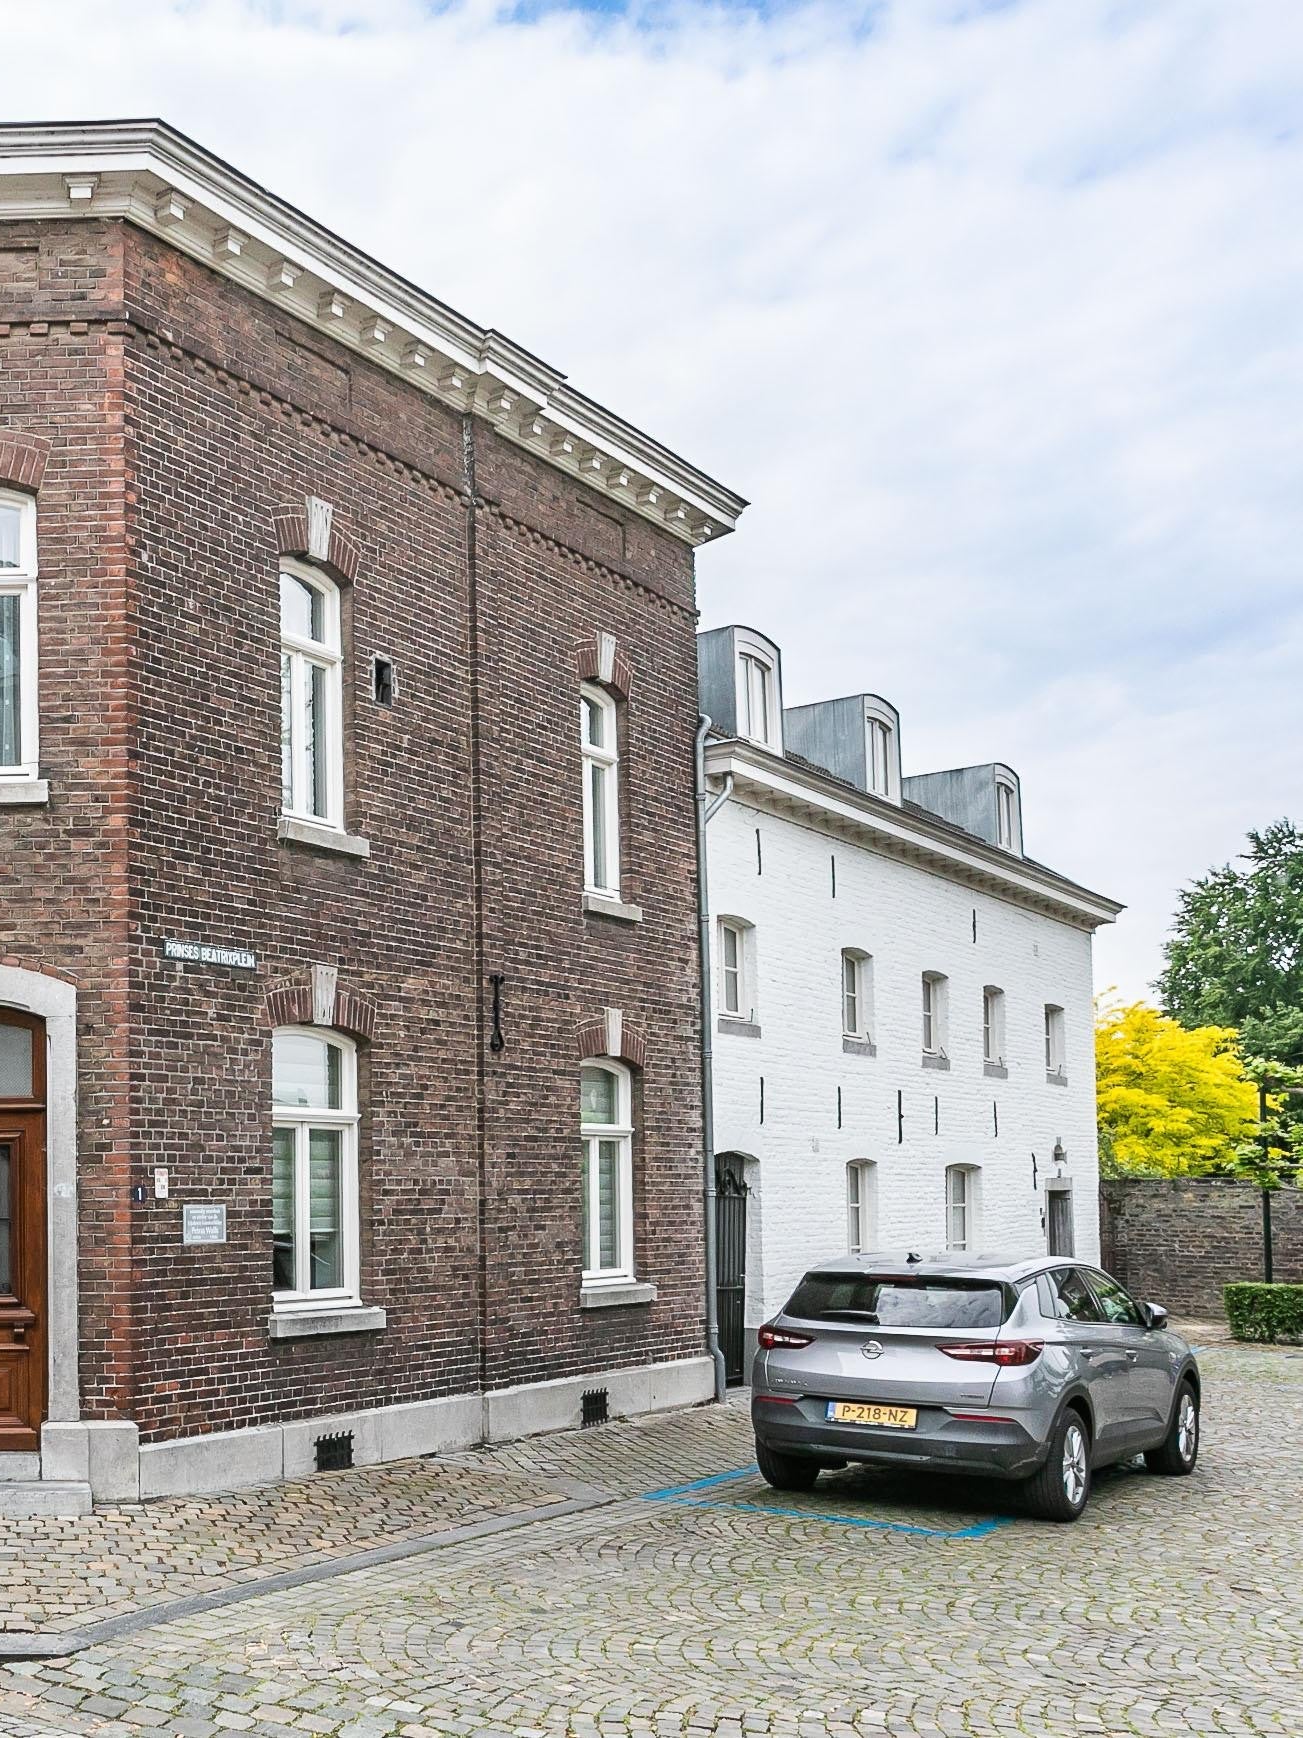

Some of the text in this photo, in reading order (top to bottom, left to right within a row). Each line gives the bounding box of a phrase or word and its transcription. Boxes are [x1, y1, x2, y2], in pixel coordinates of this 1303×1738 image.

[165, 942, 255, 967] PRINSES BEATRIXPLEIN
[137, 1187, 142, 1200] 1
[841, 1404, 909, 1423] P-218-NZ
